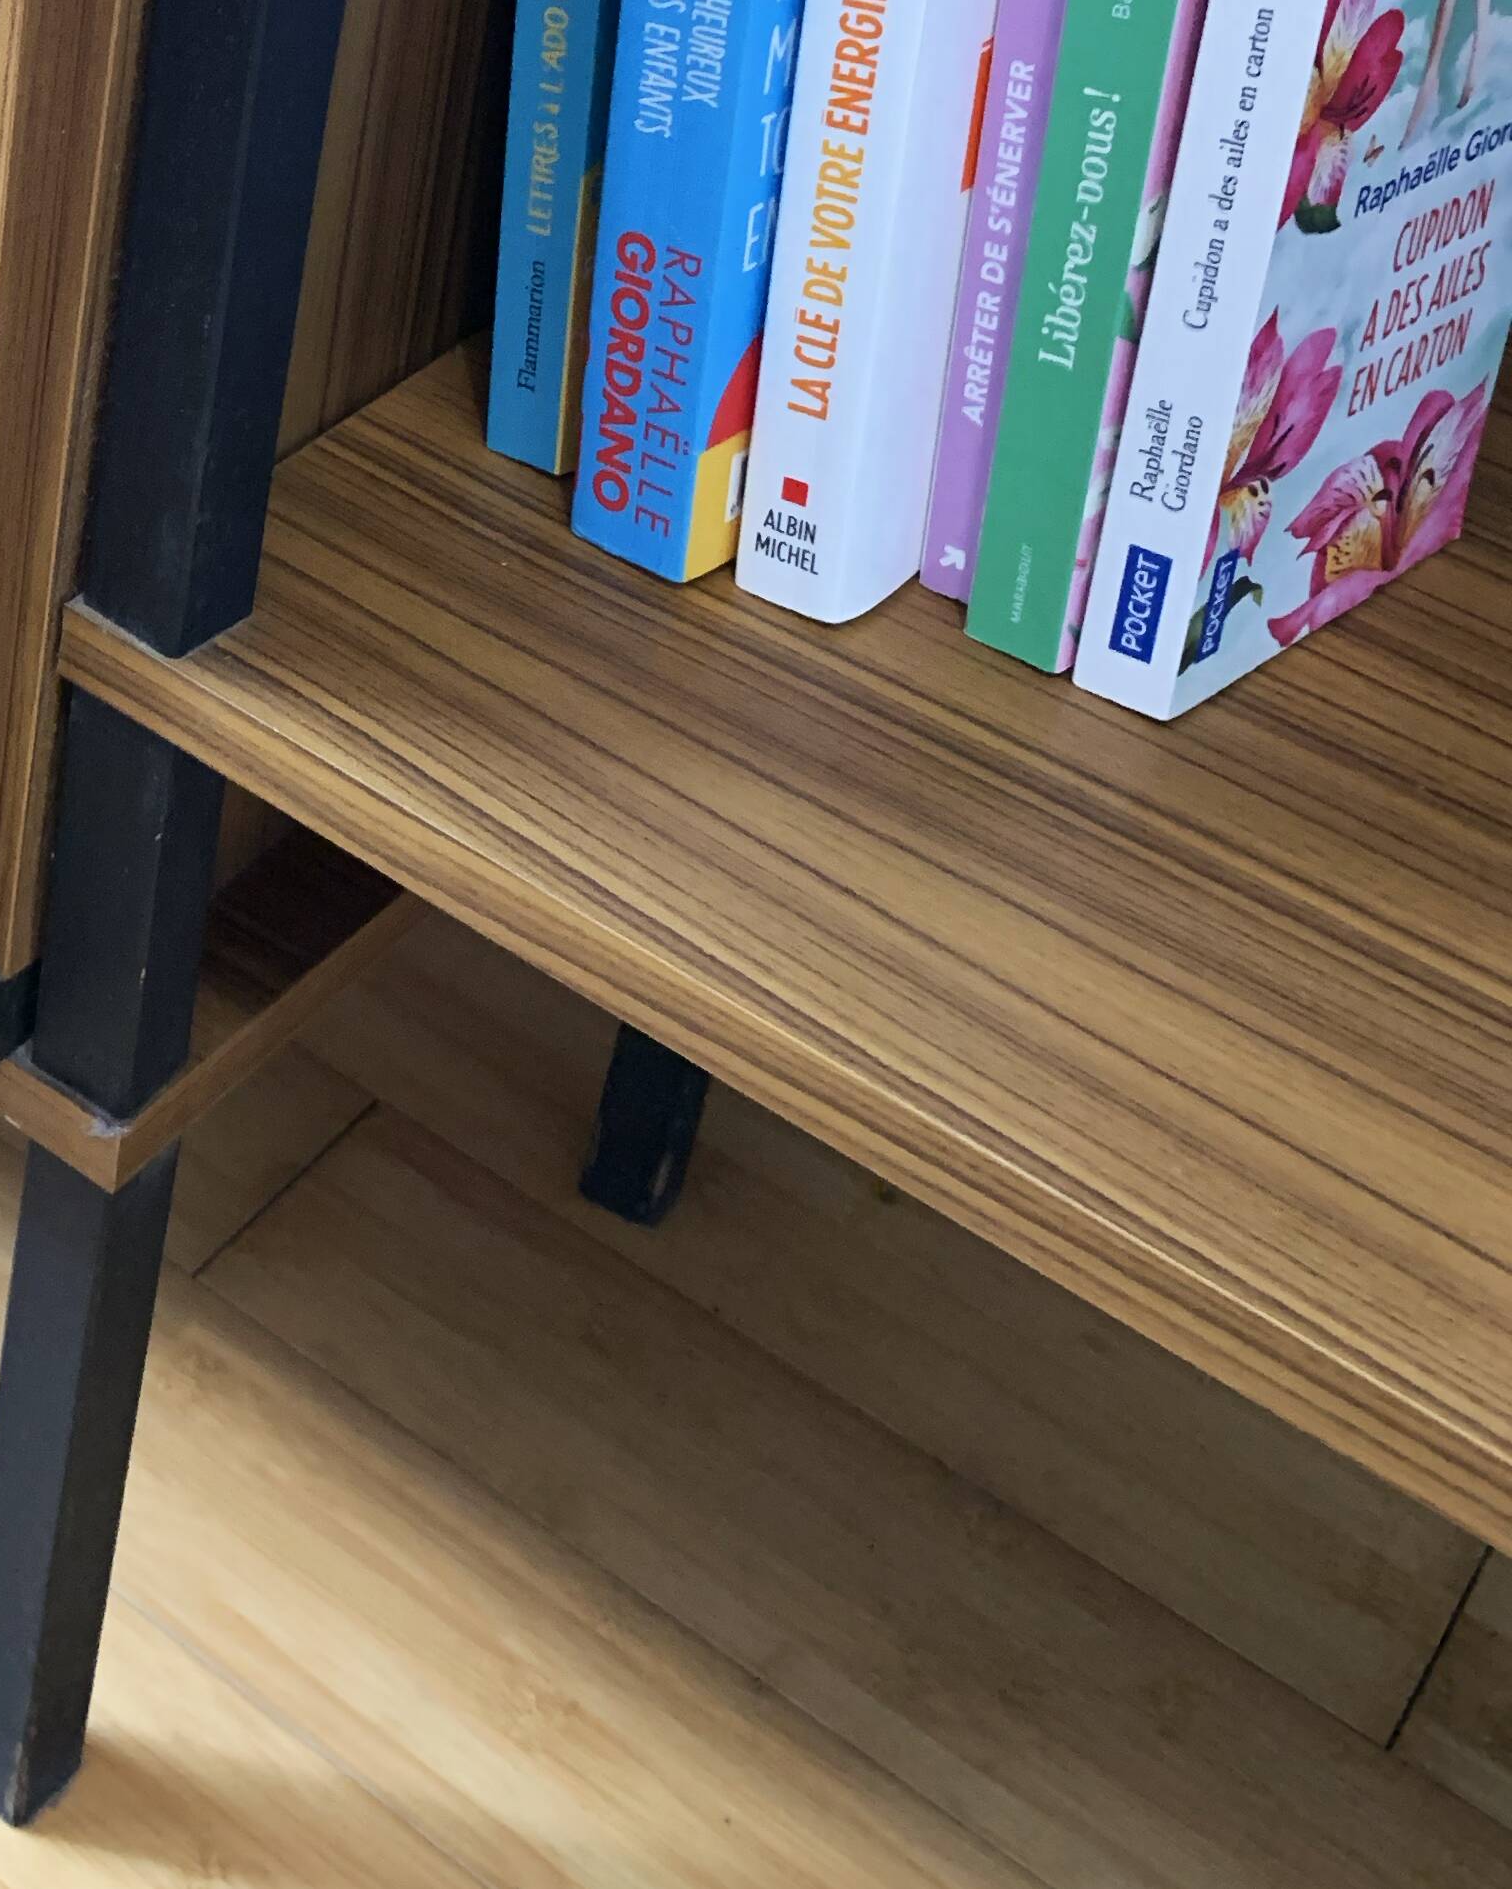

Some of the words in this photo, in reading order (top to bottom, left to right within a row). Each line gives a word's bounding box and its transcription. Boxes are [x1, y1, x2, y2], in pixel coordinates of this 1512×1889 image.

[635, 22, 682, 138] ENFANTS
[1247, 7, 1276, 79] carton
[1229, 115, 1251, 168] ailes
[1242, 82, 1258, 113] en
[526, 122, 559, 236] LETTRES
[808, 137, 865, 252] VOTRE
[984, 59, 1036, 235] S'ÉNERVER
[1219, 168, 1240, 212] des
[1354, 145, 1461, 219] Raphaëlle
[981, 235, 1010, 286] DE
[1218, 216, 1230, 232] a
[1393, 178, 1495, 273] CUPIDON
[517, 261, 546, 393] Flammarion
[801, 254, 849, 309] DE
[1183, 235, 1229, 331] Cupidon
[1360, 299, 1379, 352] A
[1382, 273, 1429, 341] DES
[1426, 241, 1492, 317] AILES
[591, 231, 657, 513] GIORDANO
[634, 245, 703, 539] RAPHAËLLE
[786, 377, 832, 422] LA
[960, 291, 1002, 427] ARRÊTER
[1347, 357, 1384, 417] EN
[1384, 307, 1473, 398] CARTON
[1129, 399, 1173, 502] Raphaëlle
[1161, 415, 1203, 513] Giordano
[754, 531, 819, 576] MICHEL
[763, 508, 817, 545] ALBIN
